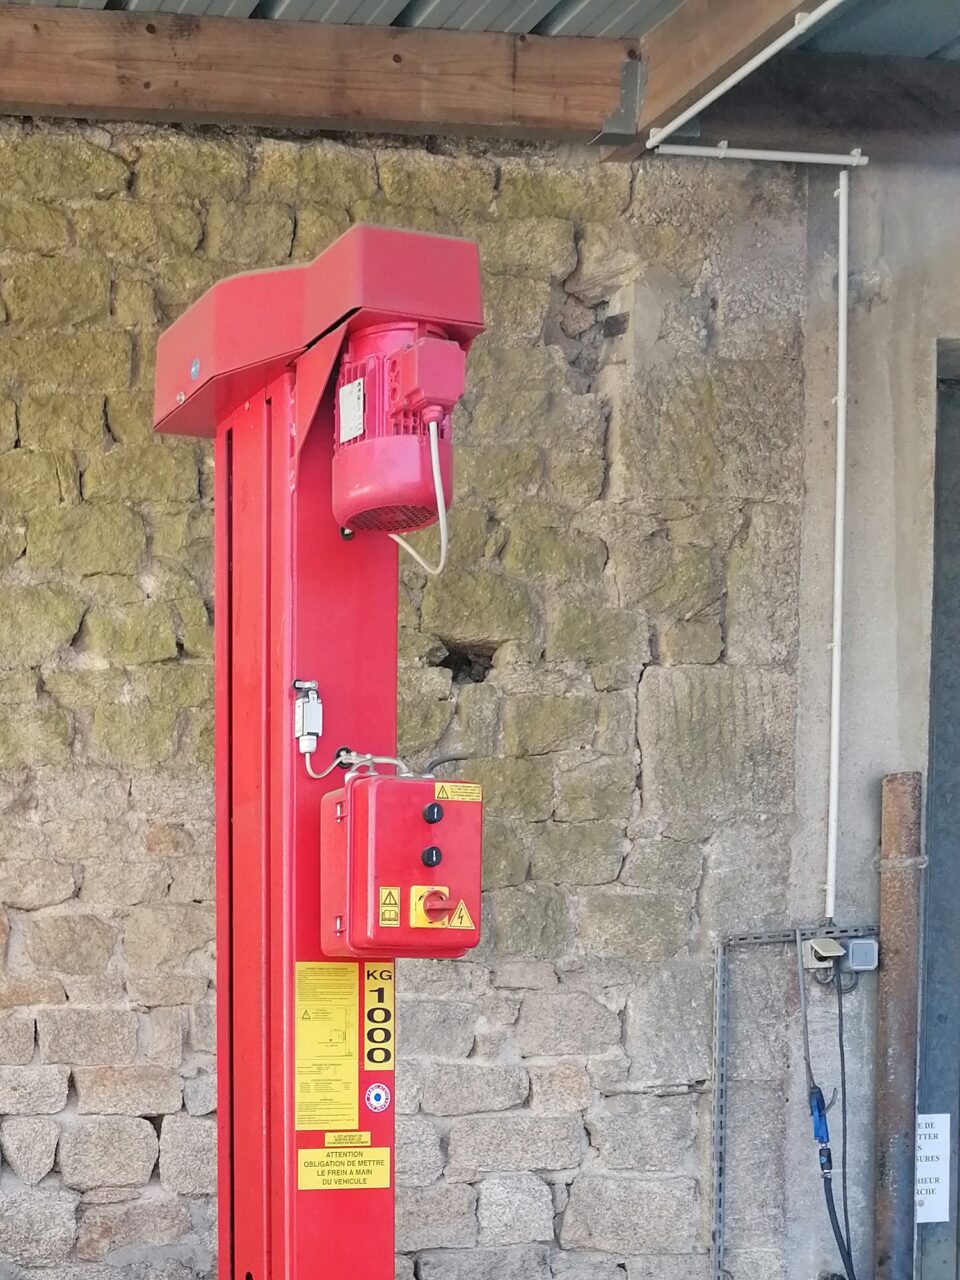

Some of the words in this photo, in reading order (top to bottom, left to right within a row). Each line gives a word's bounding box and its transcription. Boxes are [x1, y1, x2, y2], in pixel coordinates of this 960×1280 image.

[367, 969, 392, 980] KG
[367, 987, 392, 1064] 1000
[303, 1160, 345, 1168] OBLIGATION
